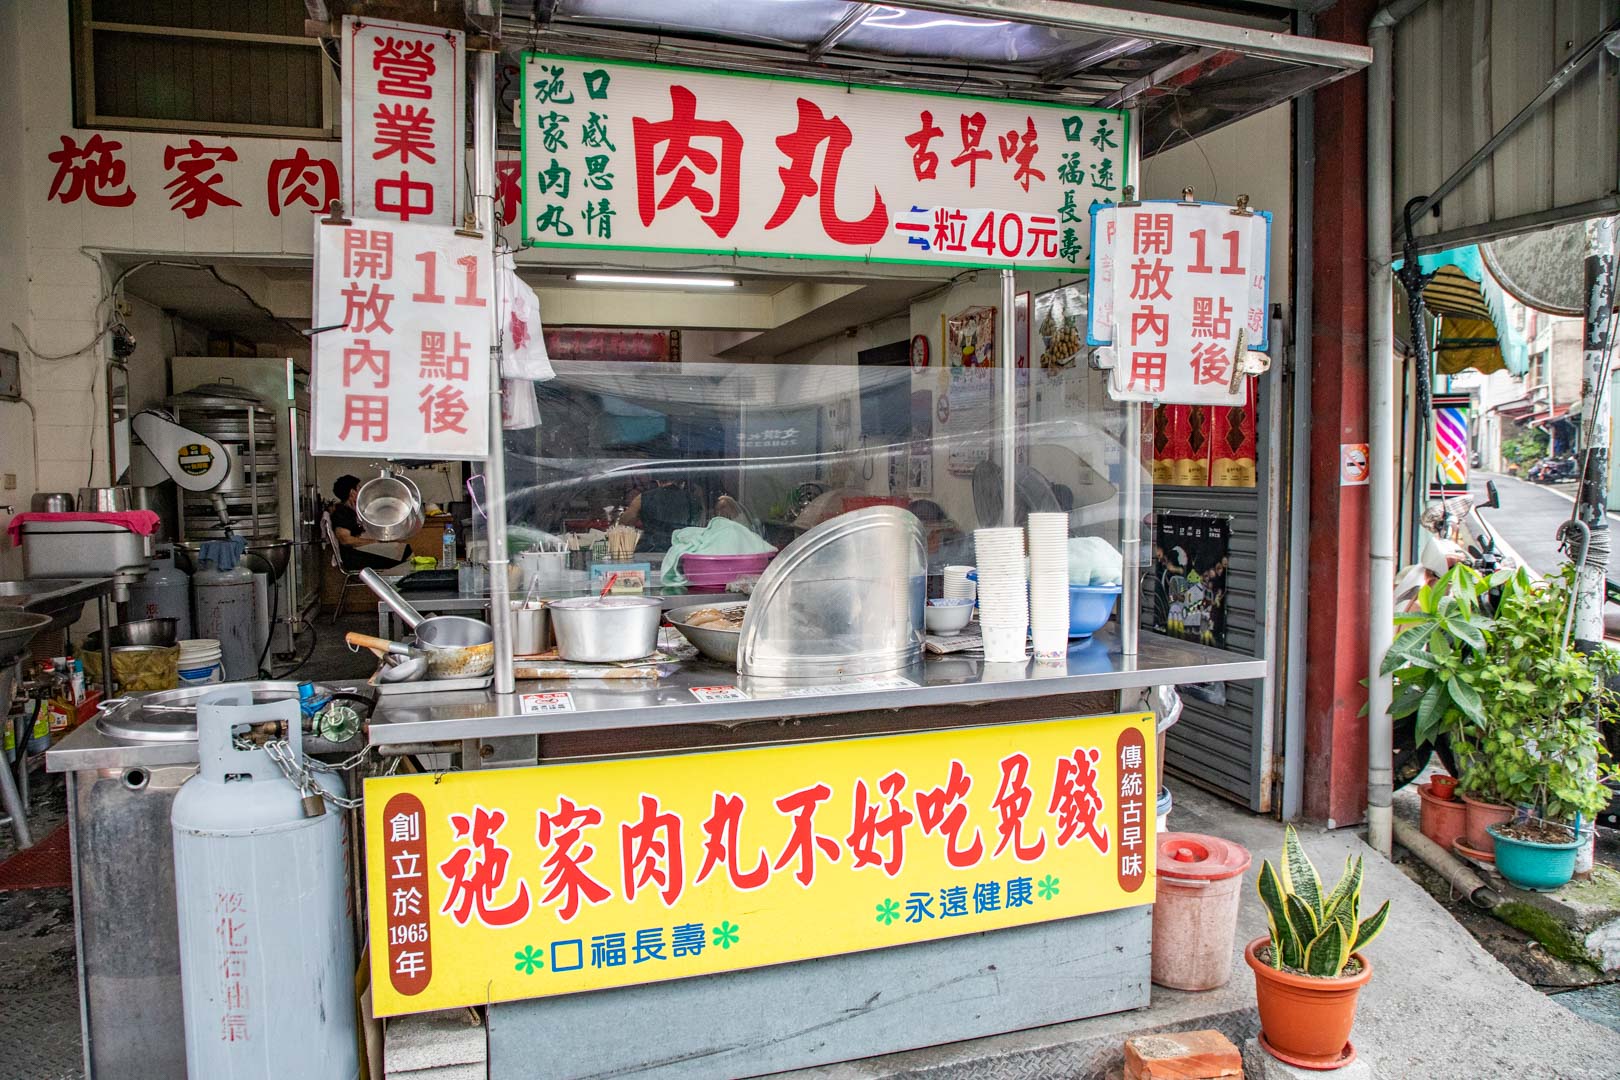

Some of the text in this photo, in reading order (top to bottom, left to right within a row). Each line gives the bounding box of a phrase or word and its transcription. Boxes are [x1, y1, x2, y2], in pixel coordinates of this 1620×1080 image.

[372, 36, 437, 221] 營業中
[533, 65, 575, 237] 施家肉丸
[581, 69, 616, 239] 口感思情
[632, 85, 889, 245] 肉丸
[904, 110, 1046, 193] 古早味
[1057, 115, 1085, 264] 口福長壽
[895, 207, 1058, 258] 一粒40元
[1127, 213, 1174, 392] 開放內用
[338, 228, 394, 443] 開放內用
[440, 747, 1109, 927] 施家肉丸不好吃免錢
[1120, 745, 1143, 877] 傳統古早味
[390, 811, 428, 979] 創立於1965年
[551, 922, 707, 973] 口福長壽
[905, 876, 1035, 924] 永遠健康
